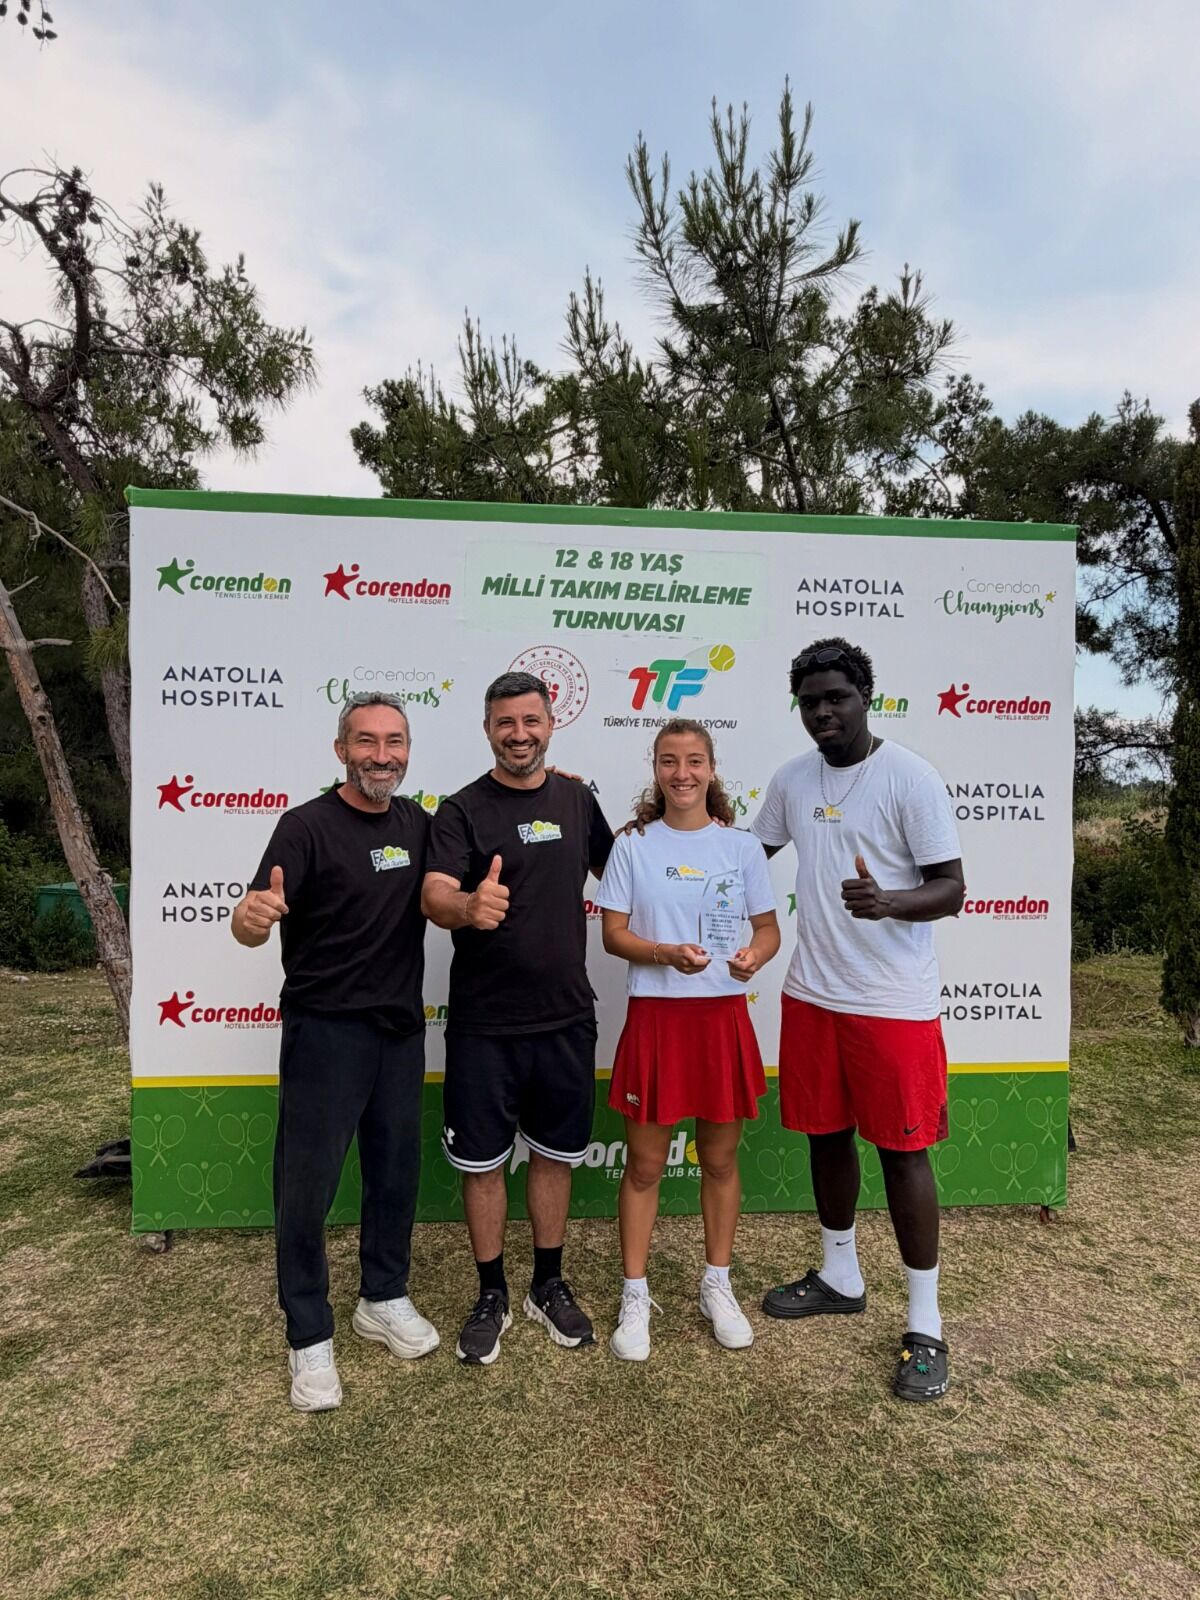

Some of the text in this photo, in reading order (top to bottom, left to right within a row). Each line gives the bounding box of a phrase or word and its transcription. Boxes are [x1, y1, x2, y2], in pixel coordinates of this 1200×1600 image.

[555, 549, 684, 576] 12 & 18 YAŞ
[190, 572, 292, 593] corendon
[356, 578, 452, 598] corendon
[481, 573, 752, 606] MİLLİ TAKIM BELİRLEME
[797, 578, 905, 596] ANATOLIA
[966, 578, 1041, 594] Corendon
[796, 600, 905, 618] HOSPITAL
[934, 590, 1046, 623] Champions
[552, 609, 686, 633] TURNUVASI
[162, 666, 284, 684] ANATOLIA
[353, 666, 436, 682] Corendon
[628, 659, 708, 711] TTF
[162, 690, 284, 708] HOSPITAL
[966, 696, 1052, 714] corendon
[603, 715, 639, 728] TÜRKİYE
[190, 788, 289, 808] corendon
[956, 805, 1045, 821] OSPITAL
[162, 882, 250, 899] ANATO
[964, 895, 1049, 914] corendon
[162, 906, 231, 923] HOSP
[940, 983, 1042, 998] ANATOLIA
